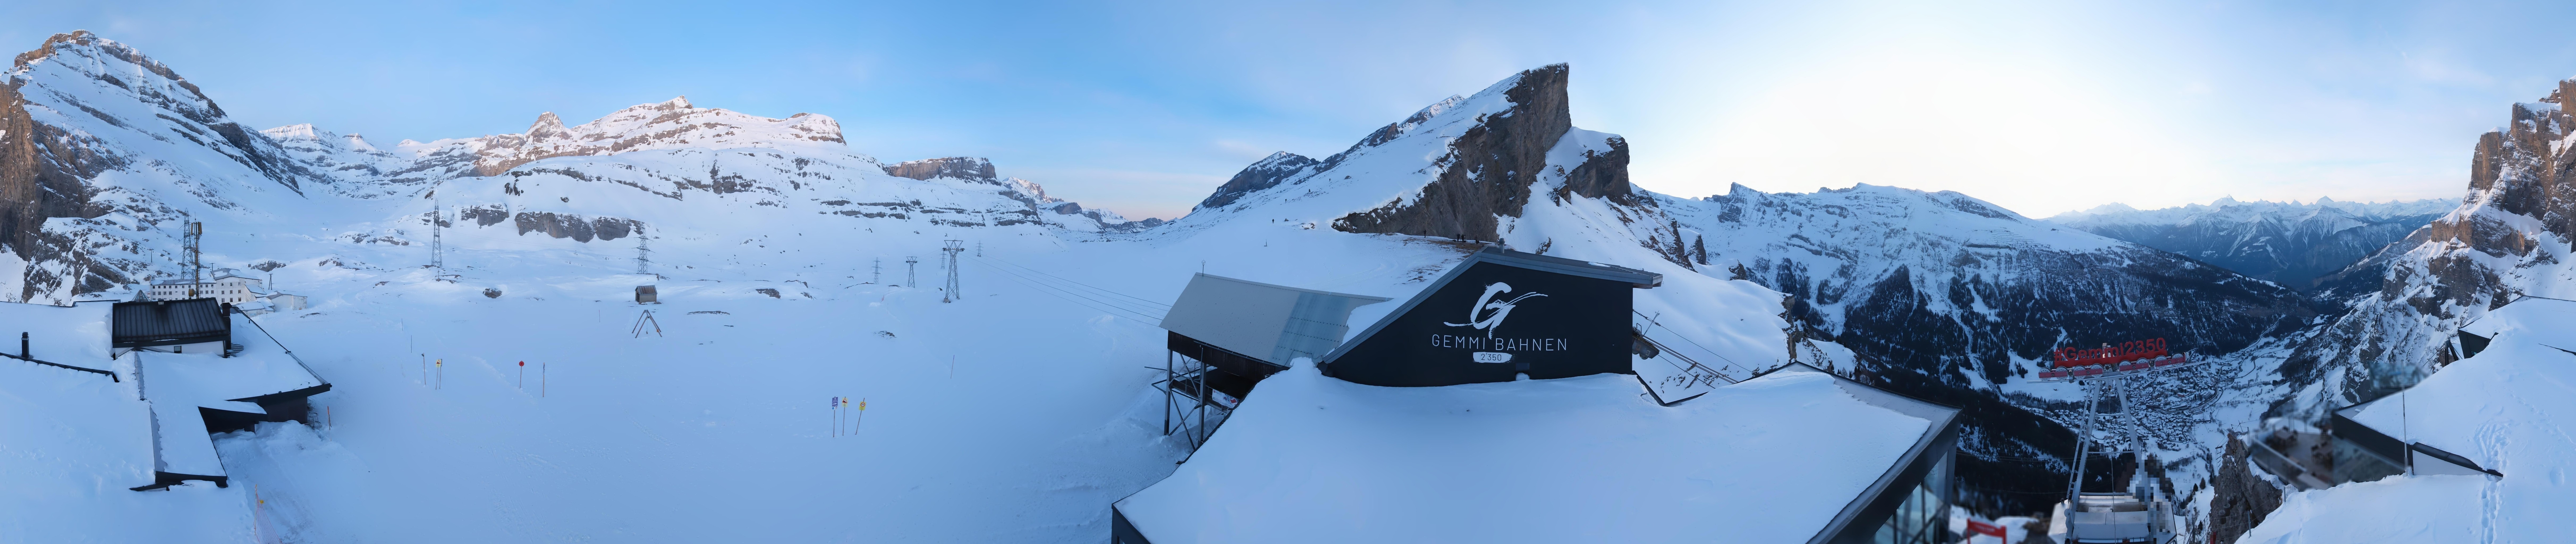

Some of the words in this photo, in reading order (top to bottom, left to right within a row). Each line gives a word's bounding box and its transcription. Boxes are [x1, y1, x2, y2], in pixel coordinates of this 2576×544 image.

[1432, 334, 1485, 350] GEMMI
[1496, 338, 1566, 351] BAHNEN
[2054, 338, 2166, 361] #Gemmi2350
